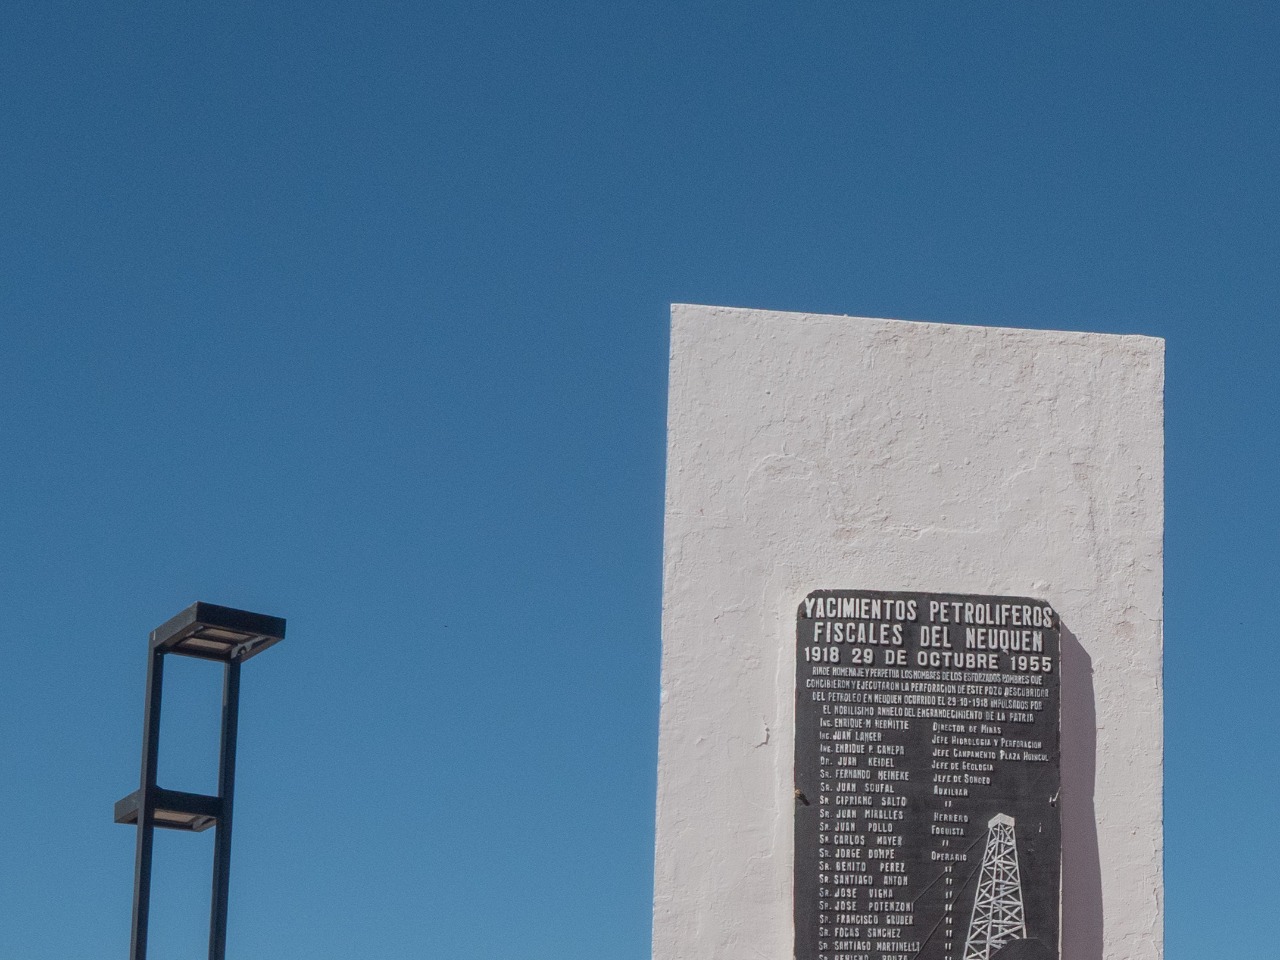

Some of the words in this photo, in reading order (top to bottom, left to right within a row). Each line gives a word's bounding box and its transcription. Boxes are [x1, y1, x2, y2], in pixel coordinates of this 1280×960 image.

[805, 597, 917, 621] YACIMIENTOS
[930, 601, 1052, 628] PETROLIFEROS
[814, 622, 903, 646] FISCALES
[921, 626, 951, 648] DEL
[966, 628, 1042, 654] NEUQUEN
[804, 647, 839, 662] 1918
[852, 649, 873, 664] 29
[886, 650, 906, 665] DE
[917, 651, 998, 669] OCTUBRE
[1011, 656, 1051, 672] 1955
[812, 666, 830, 675] RINDE
[833, 667, 864, 677] HOMENAJE
[870, 668, 899, 678] PERPETUA
[901, 670, 912, 679] LOS
[942, 672, 949, 680] DE
[951, 672, 962, 681] LOS
[1031, 676, 1042, 685] QUE
[857, 681, 899, 691] EJECUTARON
[901, 683, 909, 691] LA
[958, 685, 965, 694] DE
[967, 685, 983, 694] ESTE
[985, 687, 1002, 696] POZO
[813, 692, 825, 701] DEL
[828, 693, 860, 702] PETROLEO
[864, 694, 872, 702] EN
[874, 694, 902, 704] NEUQUEN
[904, 695, 935, 705] OCURRIDO
[938, 697, 945, 705] EL
[1031, 701, 1042, 710] POR
[823, 705, 831, 714] EL
[905, 708, 915, 716] DEL
[986, 712, 994, 720] DE
[997, 712, 1005, 720] LA
